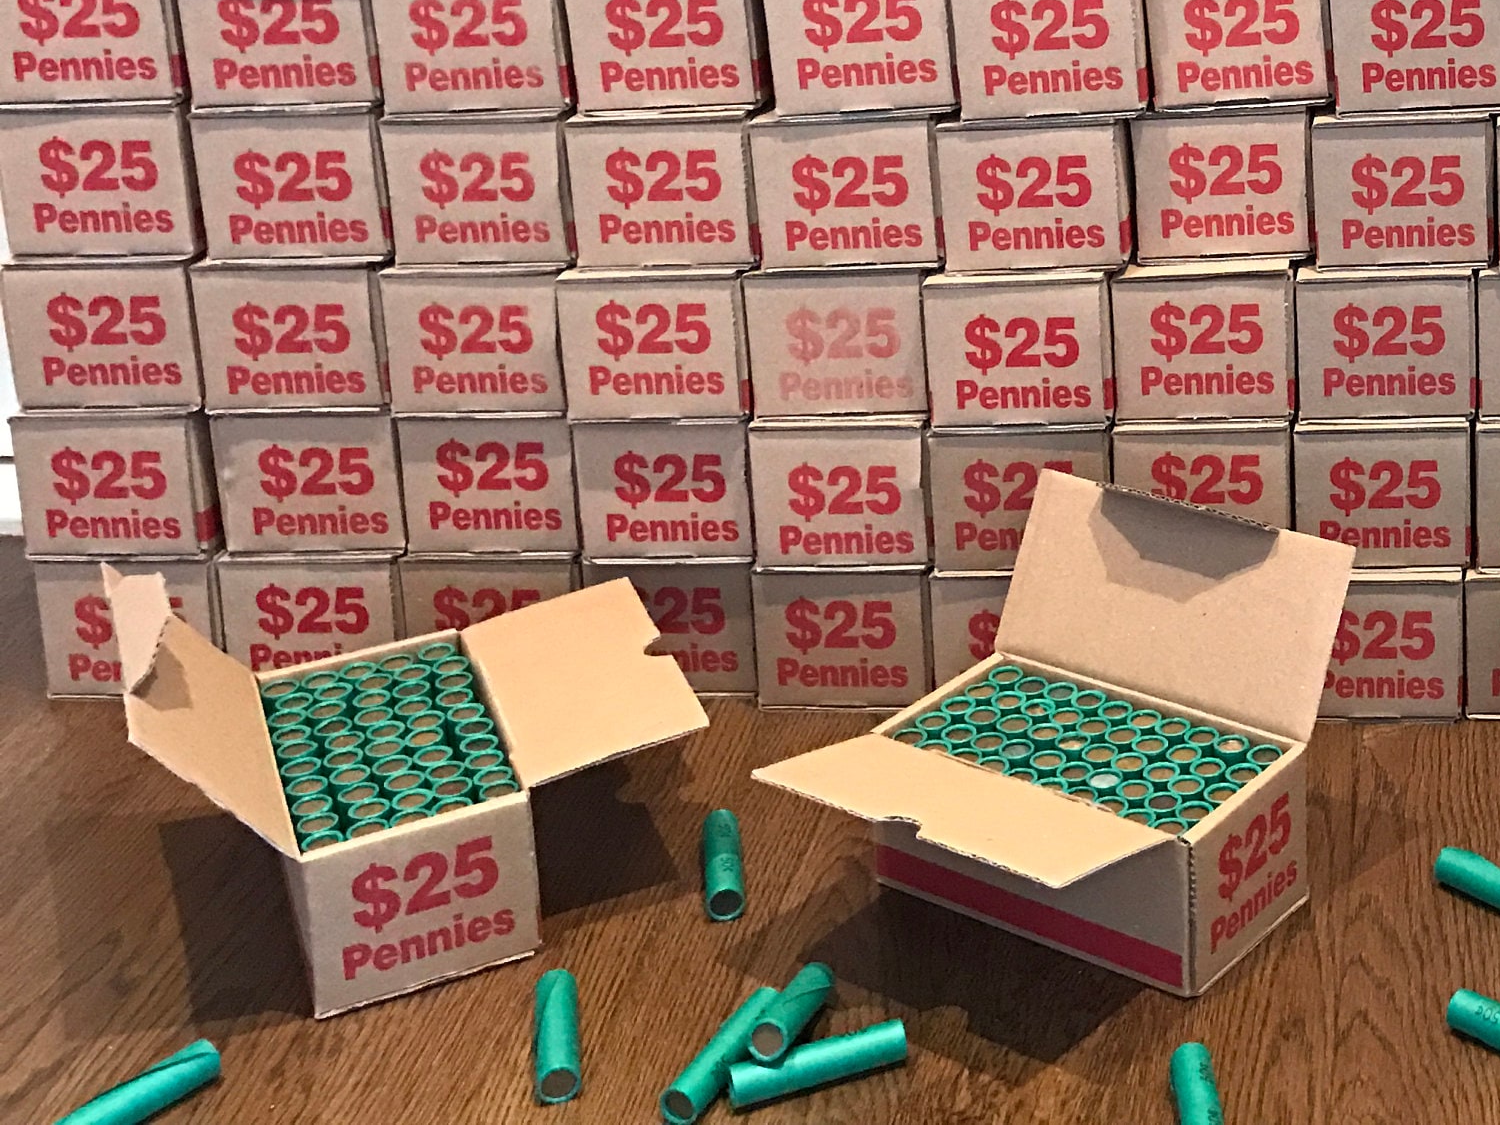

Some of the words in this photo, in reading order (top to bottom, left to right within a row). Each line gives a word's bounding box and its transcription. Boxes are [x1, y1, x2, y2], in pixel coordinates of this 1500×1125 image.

[405, 58, 544, 92] Pennies
[796, 52, 938, 90] Pennies
[419, 150, 535, 210] $25
[791, 154, 909, 217] $25
[1168, 142, 1283, 204] $25
[414, 212, 550, 244] Pennies
[785, 217, 923, 251] Pennies
[1160, 204, 1295, 239] Pennies
[418, 304, 533, 360] $25
[785, 306, 901, 366] $25
[964, 314, 1080, 376] $25
[1332, 303, 1446, 363] $25
[412, 365, 548, 394] Pennies
[779, 369, 913, 401] Pennies
[956, 377, 1091, 410] Pennies
[1323, 365, 1456, 397] Pennies
[436, 439, 549, 498] $25
[788, 463, 902, 522] $25
[1330, 457, 1442, 517] $25
[428, 500, 562, 531] Pennies
[779, 523, 914, 555] Pennies
[1319, 519, 1451, 549] Pennies
[256, 586, 370, 638] $25
[785, 598, 896, 654] $25
[777, 658, 908, 688] Pennies
[1217, 792, 1291, 899] $25
[351, 836, 500, 932] $25
[1209, 856, 1299, 955] Pennies
[342, 903, 516, 981] Pennies
